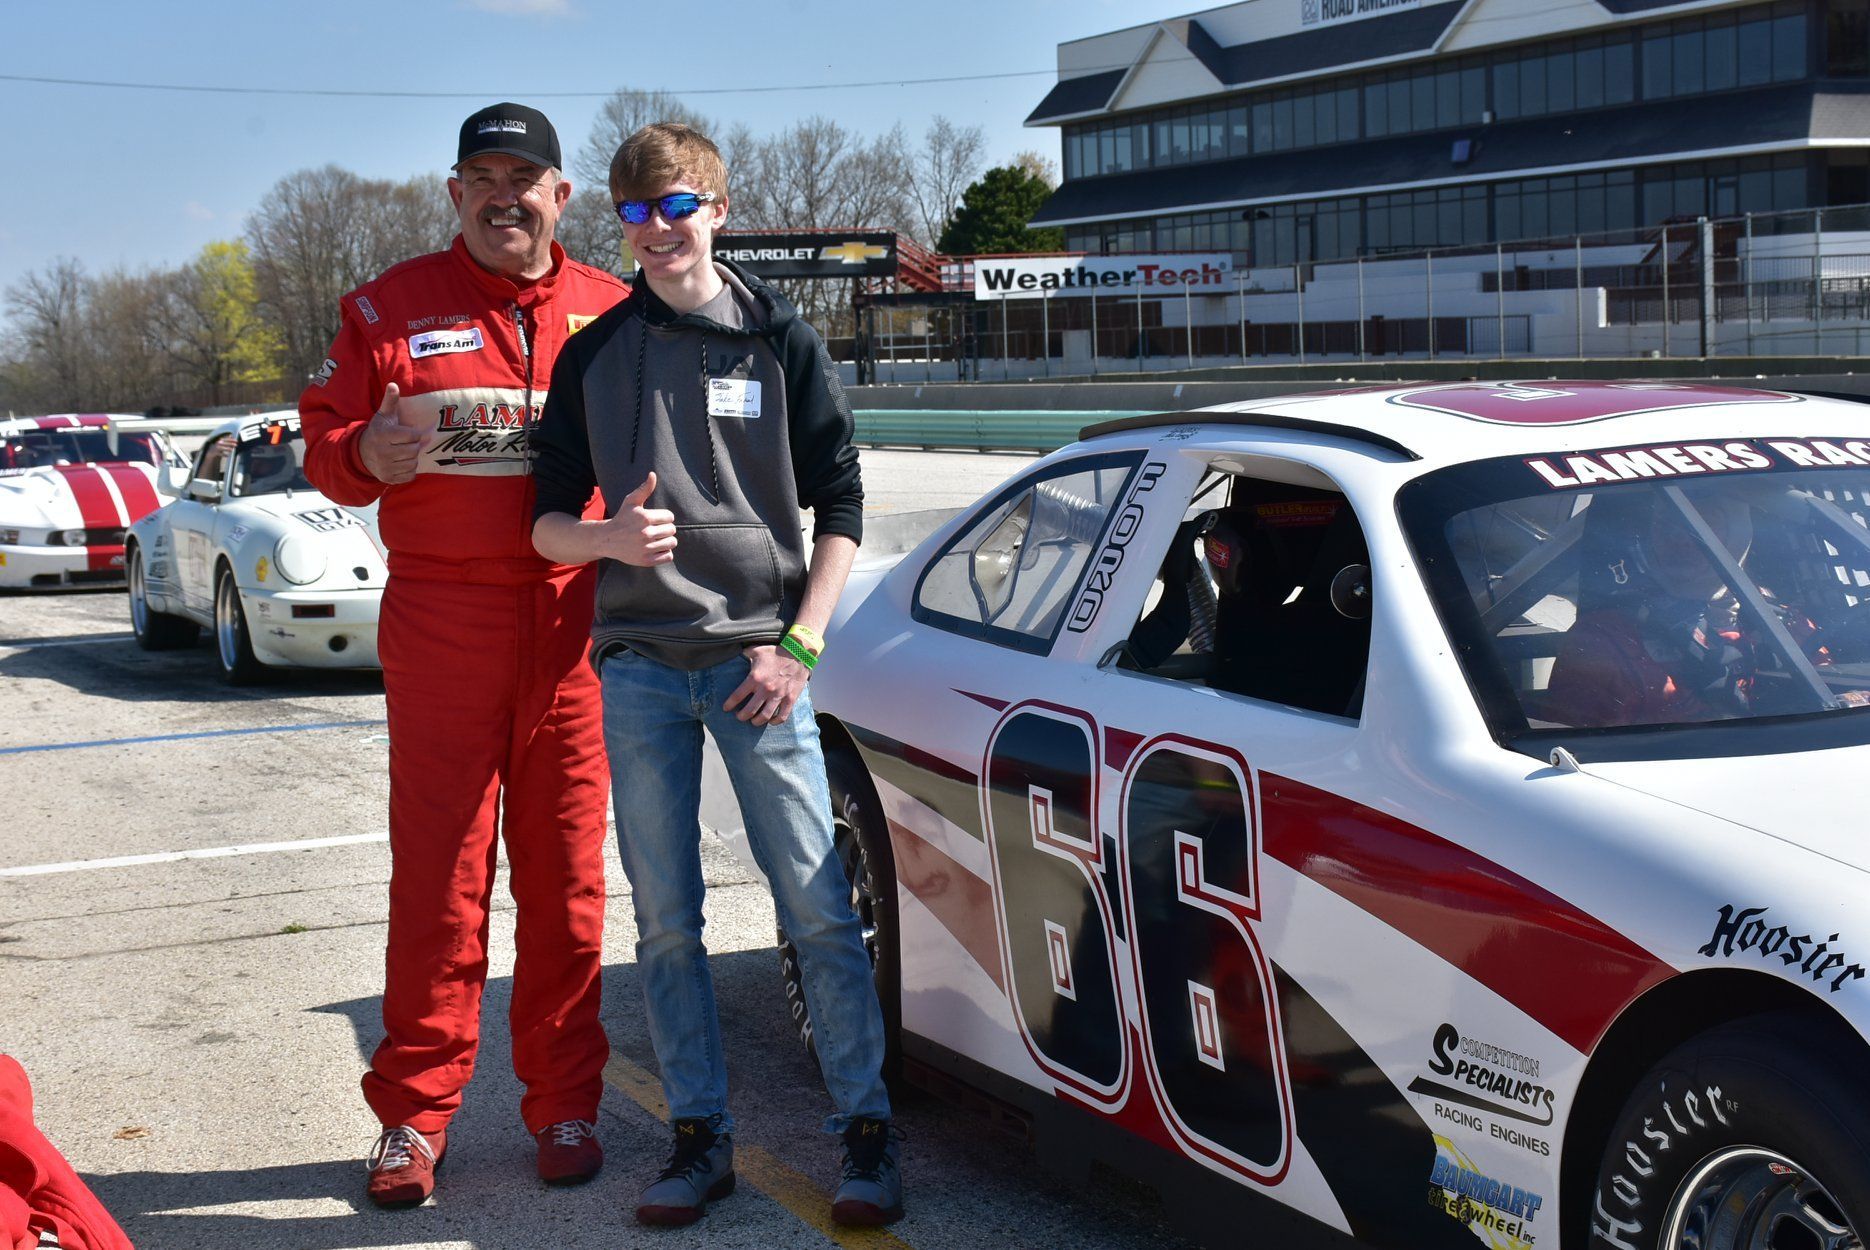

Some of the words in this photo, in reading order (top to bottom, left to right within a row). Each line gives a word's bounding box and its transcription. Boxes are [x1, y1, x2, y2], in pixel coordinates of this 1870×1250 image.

[715, 247, 815, 262] CHEVROLET
[407, 316, 435, 329] DENNY
[439, 315, 470, 325] LAMERS
[454, 339, 474, 348] Am
[427, 430, 498, 454] Motor
[1528, 442, 1771, 488] LAMERS
[1067, 462, 1167, 633] FORD
[979, 698, 1297, 1187] 66
[1697, 904, 1866, 993] Hoosier
[1429, 1023, 1554, 1107] SPECIALISTS
[1460, 1036, 1540, 1078] COMPETITION
[1435, 1103, 1483, 1131] RACING
[1490, 1123, 1550, 1156] ENGINES
[1430, 1154, 1543, 1222] BAUMGART
[1592, 1080, 1728, 1250] Hoosier
